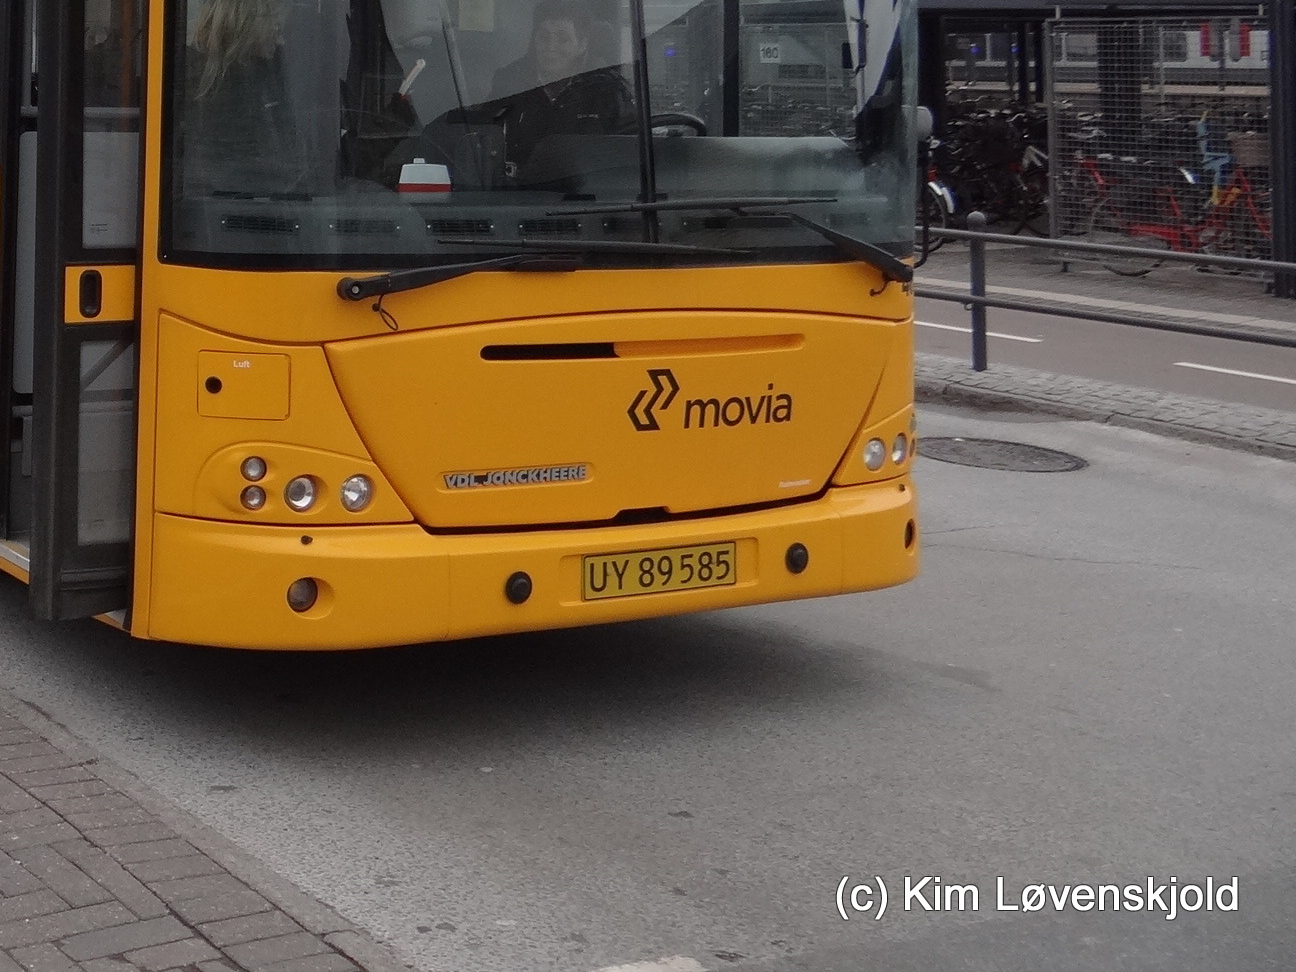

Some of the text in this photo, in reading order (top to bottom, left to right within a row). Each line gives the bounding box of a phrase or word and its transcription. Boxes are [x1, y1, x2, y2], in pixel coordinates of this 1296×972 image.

[233, 359, 251, 368] Luft
[683, 382, 793, 429] movia
[444, 465, 587, 488] VDL JONCKHEERE
[589, 560, 630, 593] UY
